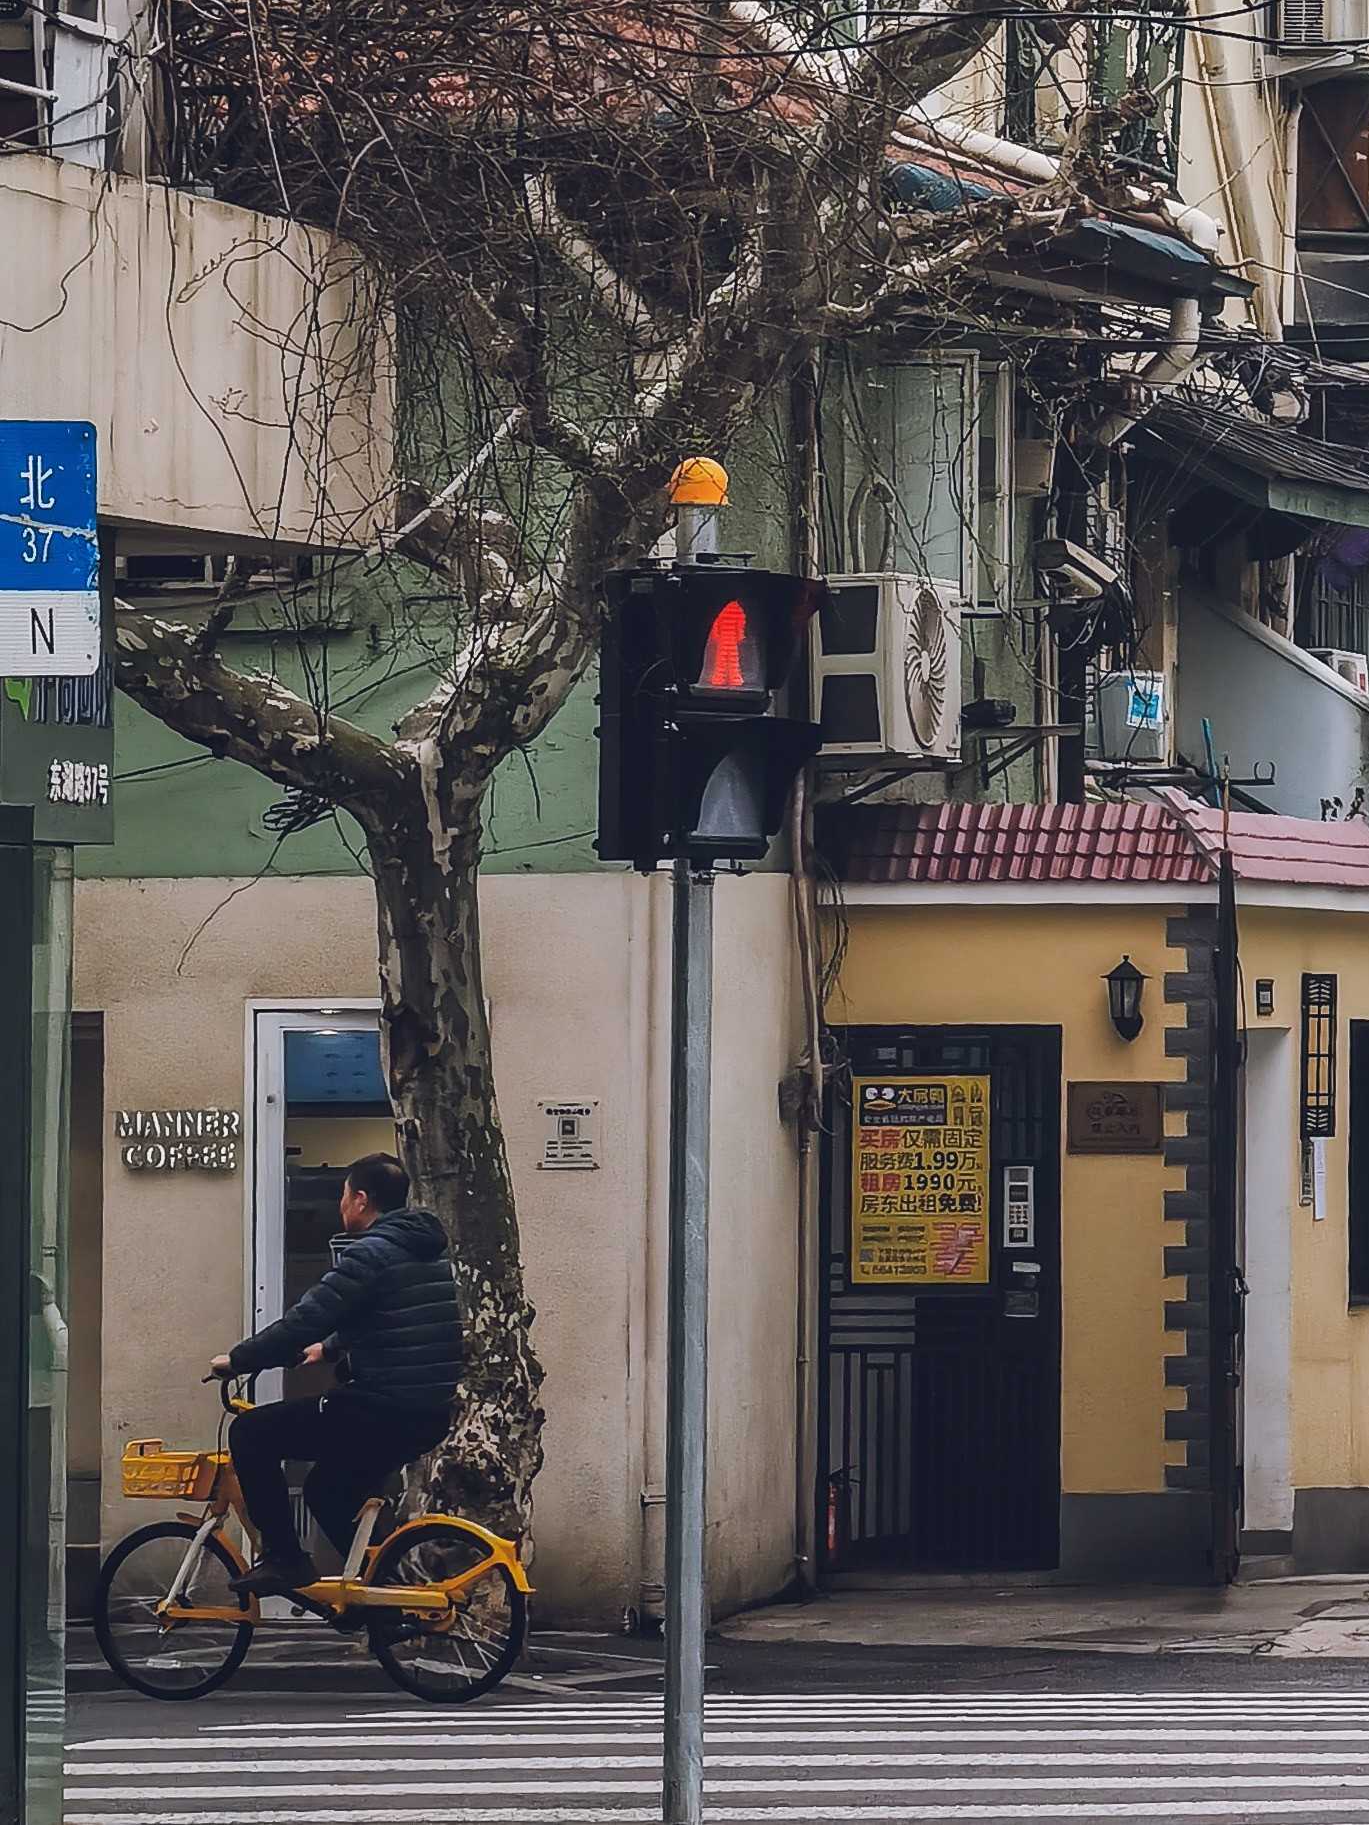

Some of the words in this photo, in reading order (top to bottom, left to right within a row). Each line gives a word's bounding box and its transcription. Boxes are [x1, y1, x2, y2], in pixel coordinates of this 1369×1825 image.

[20, 455, 55, 509] 北
[22, 527, 53, 562] 37
[31, 608, 54, 654] N
[118, 1110, 240, 1138] MANNER
[860, 1129, 983, 1149] 买房仅需固定
[124, 1142, 237, 1170] COFFEE
